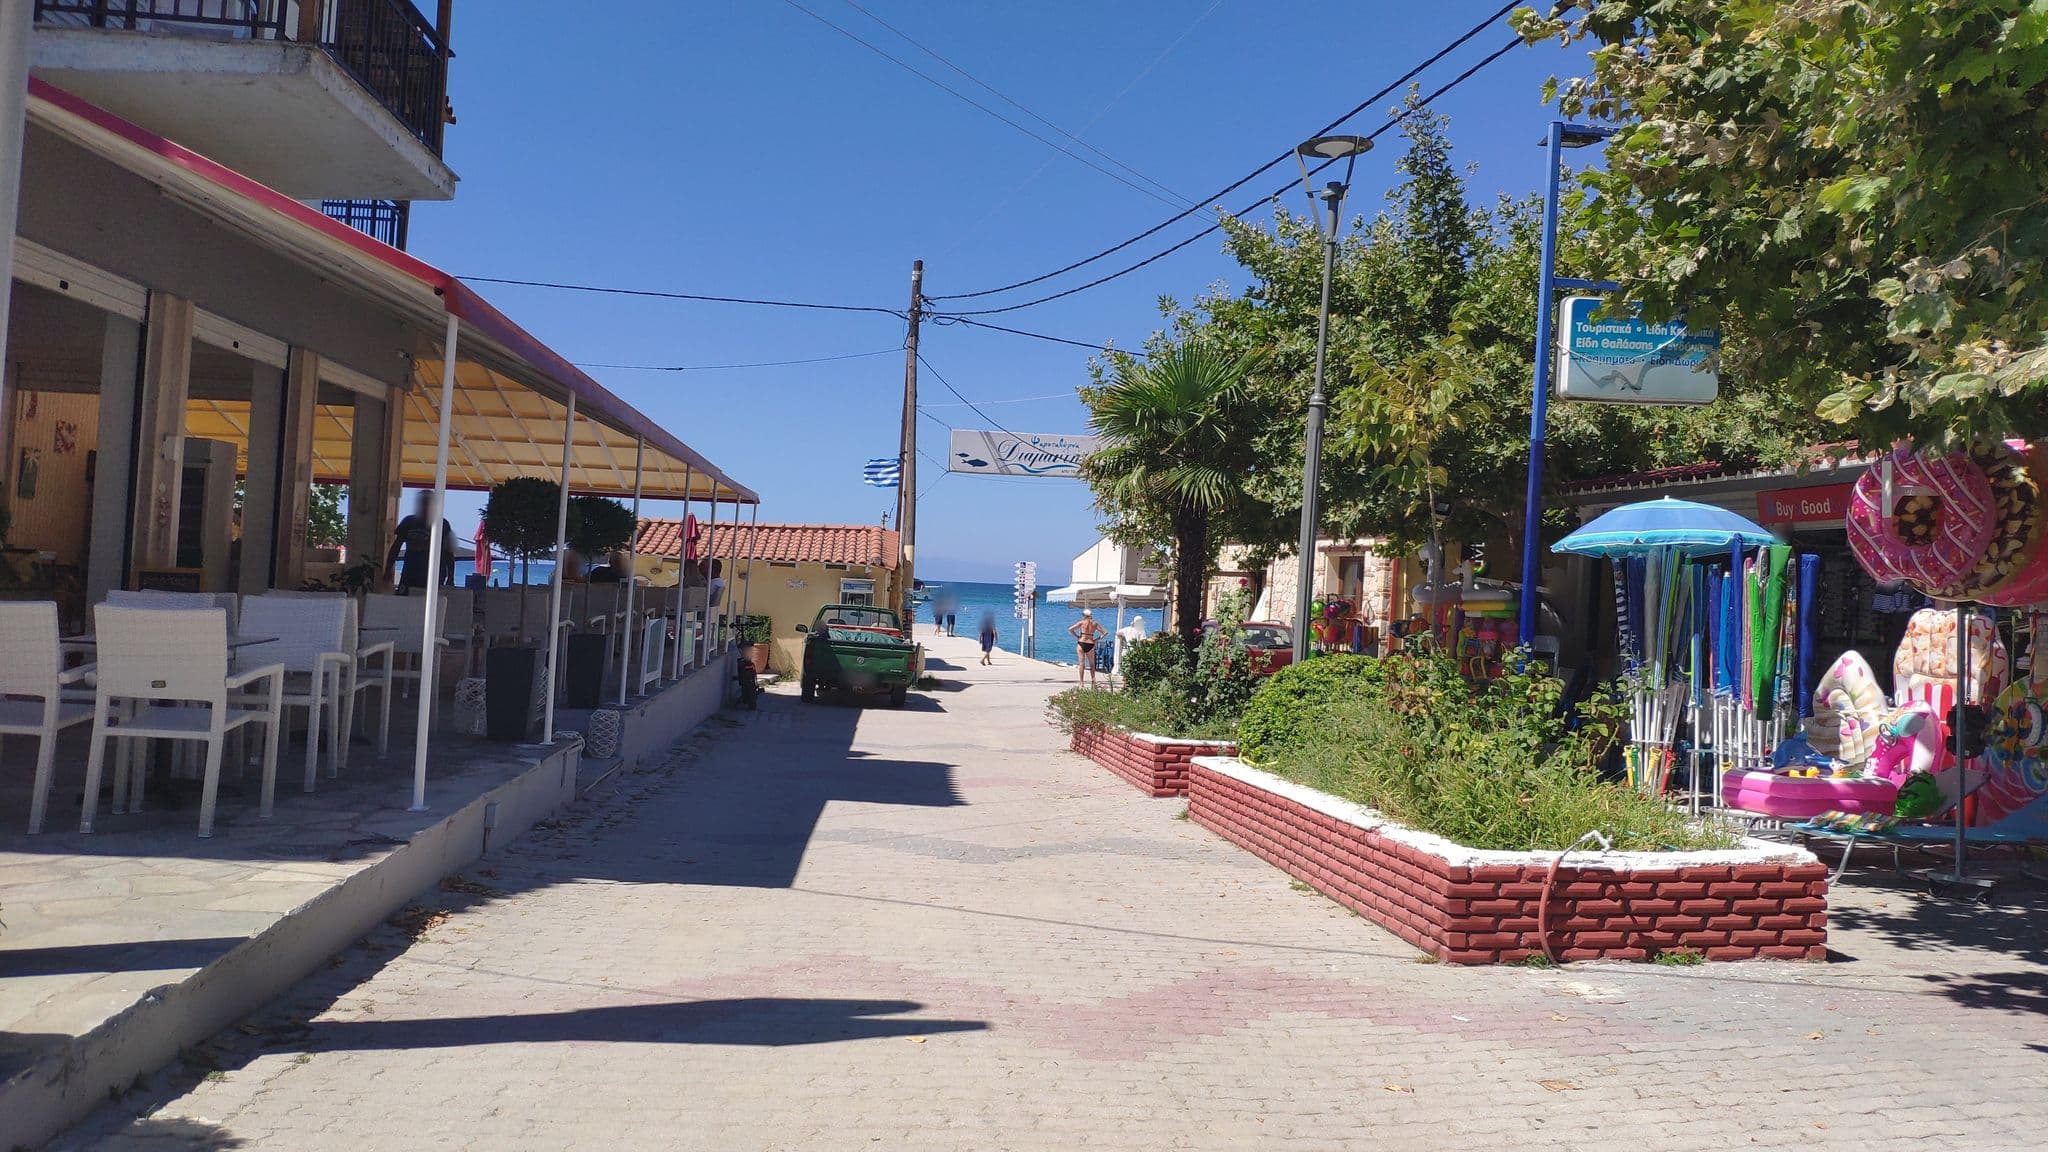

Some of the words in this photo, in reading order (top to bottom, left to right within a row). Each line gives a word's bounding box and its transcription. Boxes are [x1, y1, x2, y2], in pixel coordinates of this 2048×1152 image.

[1576, 337, 1599, 349] Είδη
[1601, 337, 1653, 350] Θαλάσσης
[1776, 502, 1794, 520] Buy
[1801, 498, 1831, 515] Good
